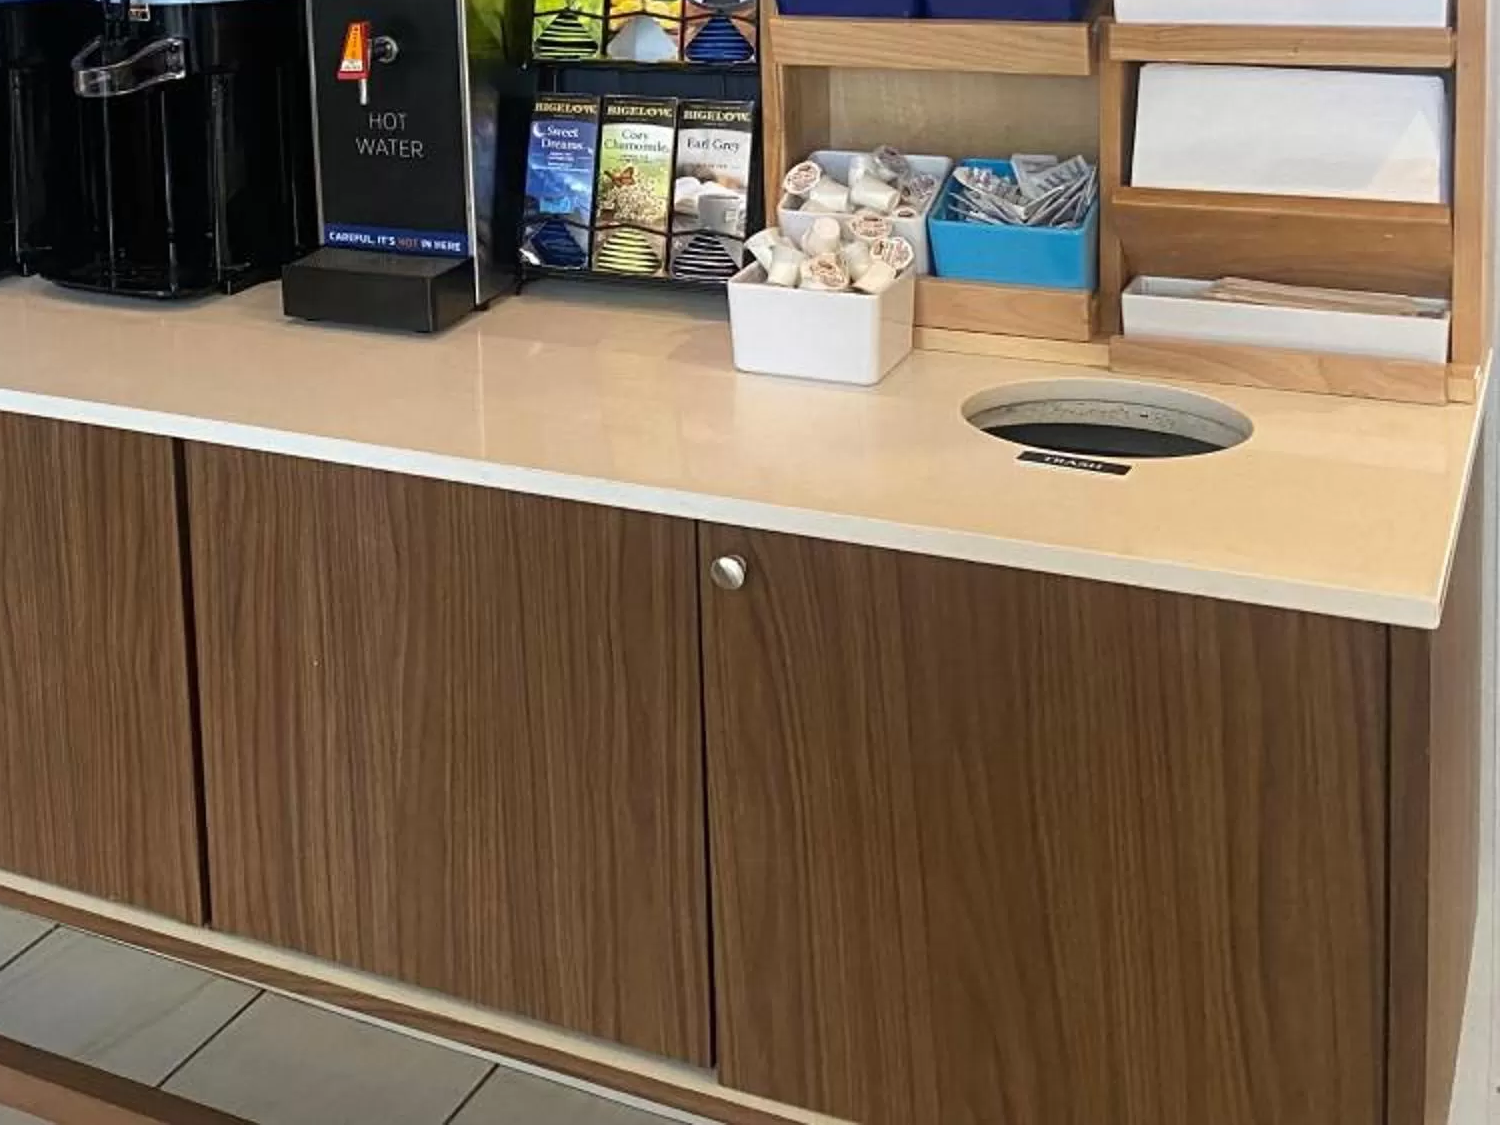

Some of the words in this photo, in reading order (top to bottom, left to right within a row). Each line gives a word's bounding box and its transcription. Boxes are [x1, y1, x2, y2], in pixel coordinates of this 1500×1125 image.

[369, 112, 407, 130] HOT
[355, 138, 424, 158] WATER
[1043, 455, 1104, 471] TRASH
